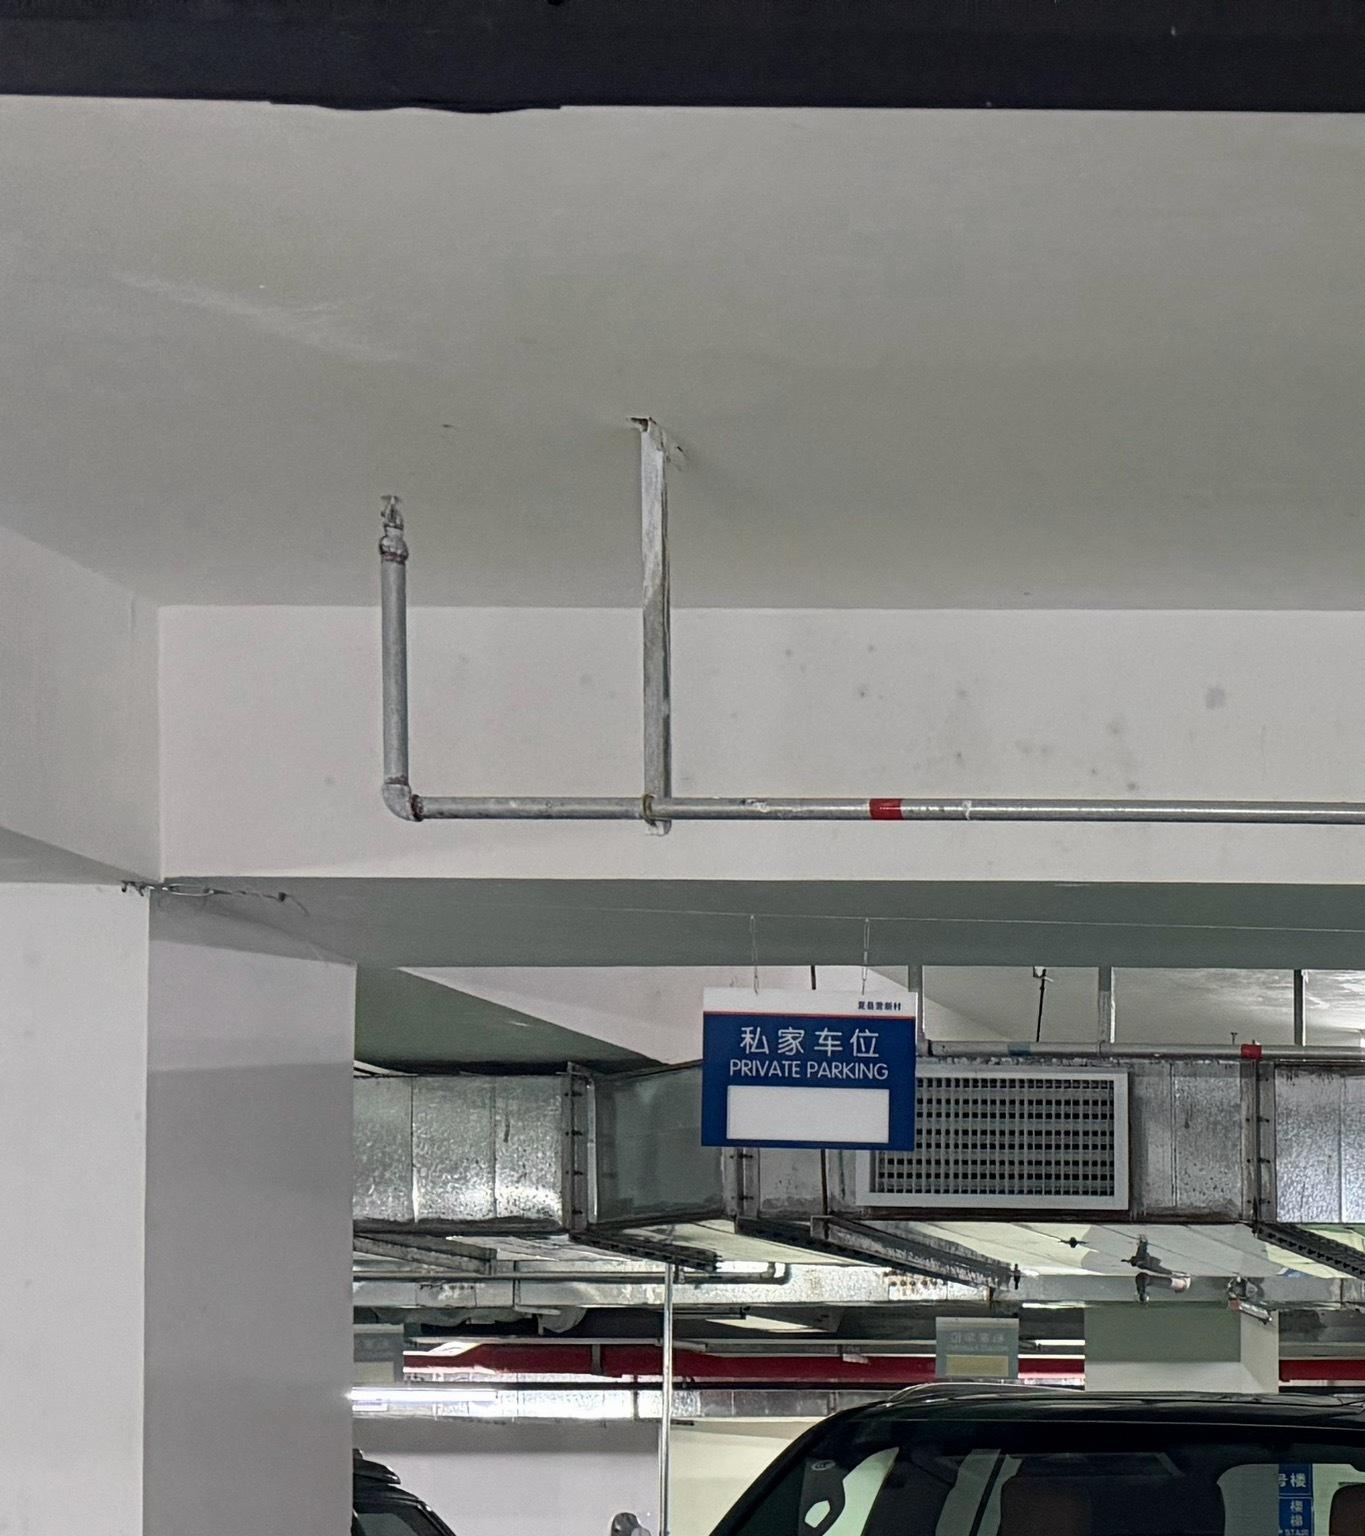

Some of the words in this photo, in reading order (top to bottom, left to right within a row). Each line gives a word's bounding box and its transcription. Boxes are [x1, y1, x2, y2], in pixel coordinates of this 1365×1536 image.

[740, 1026, 880, 1058] 私家车位
[729, 1059, 801, 1079] PRIVATE
[806, 1060, 889, 1081] PARKING
